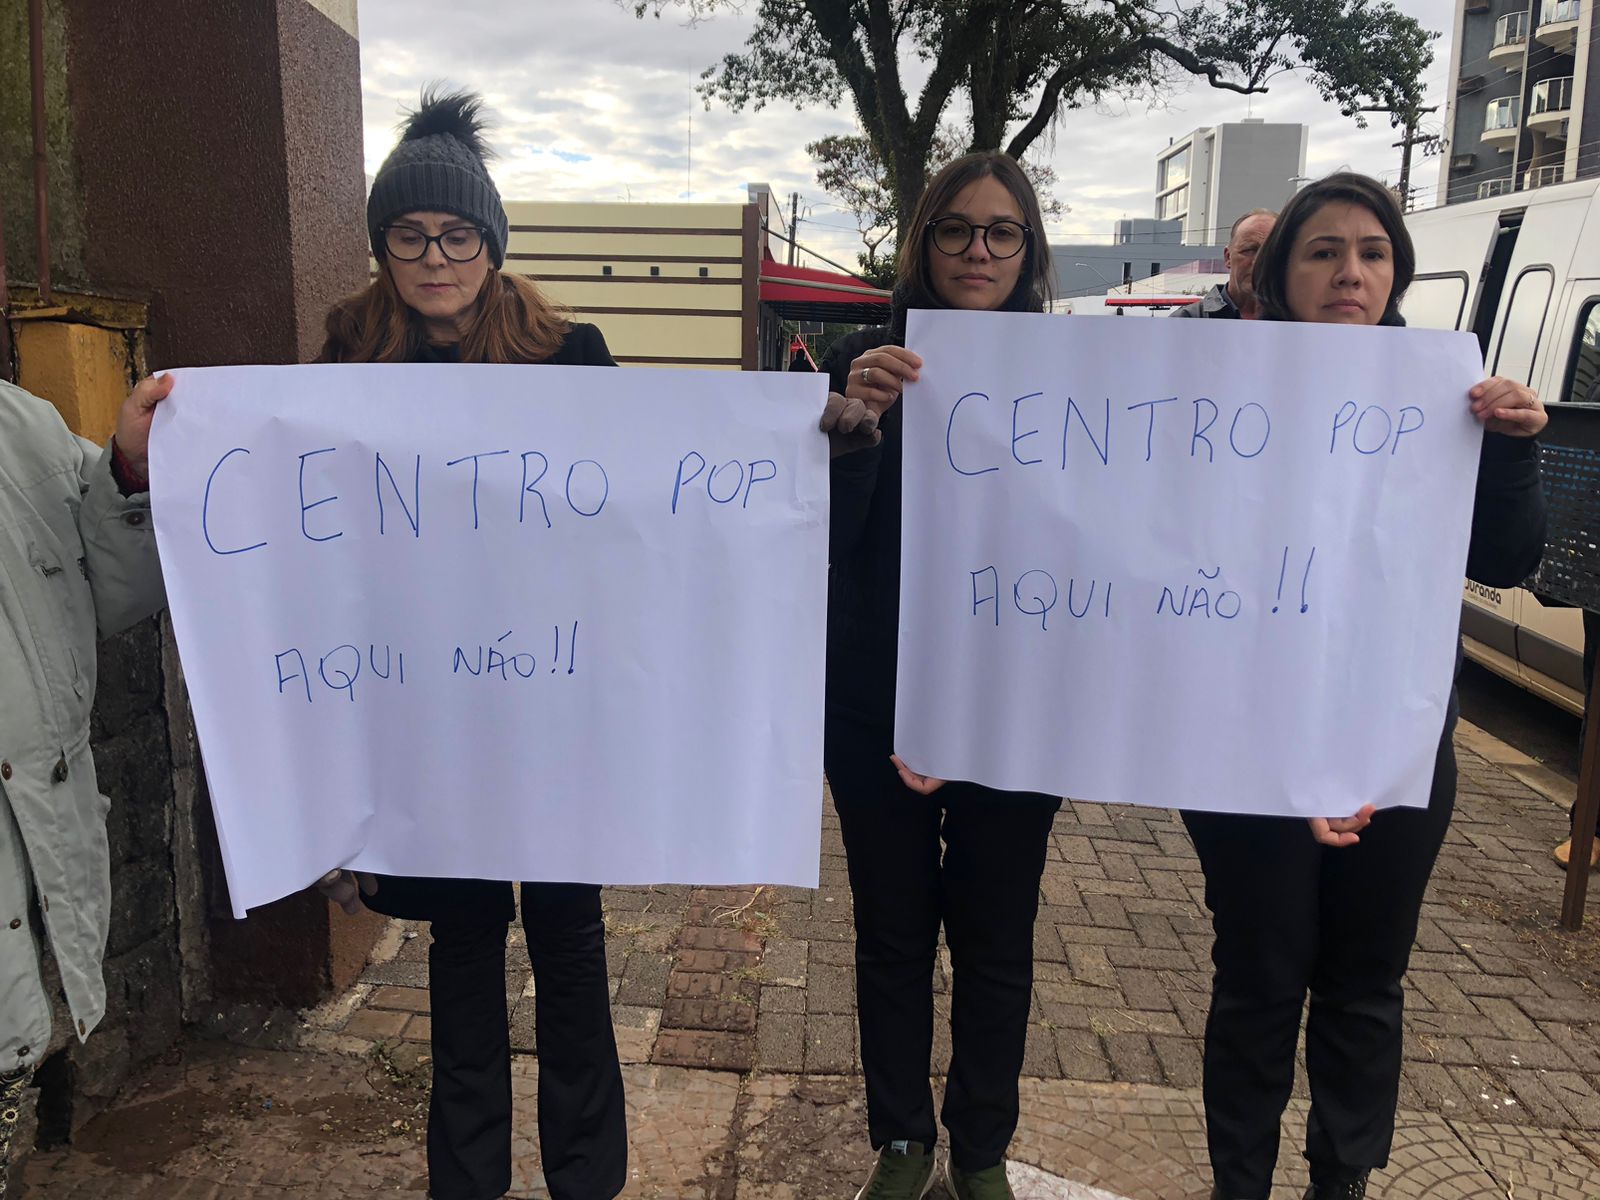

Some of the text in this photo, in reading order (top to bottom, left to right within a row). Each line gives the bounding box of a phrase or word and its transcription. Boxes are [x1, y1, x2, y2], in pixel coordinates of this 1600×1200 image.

[946, 391, 1426, 477] CENTRO POP
[202, 447, 778, 556] CENTRO POP
[970, 566, 1111, 631] AQUI
[276, 645, 406, 703] AQUI
